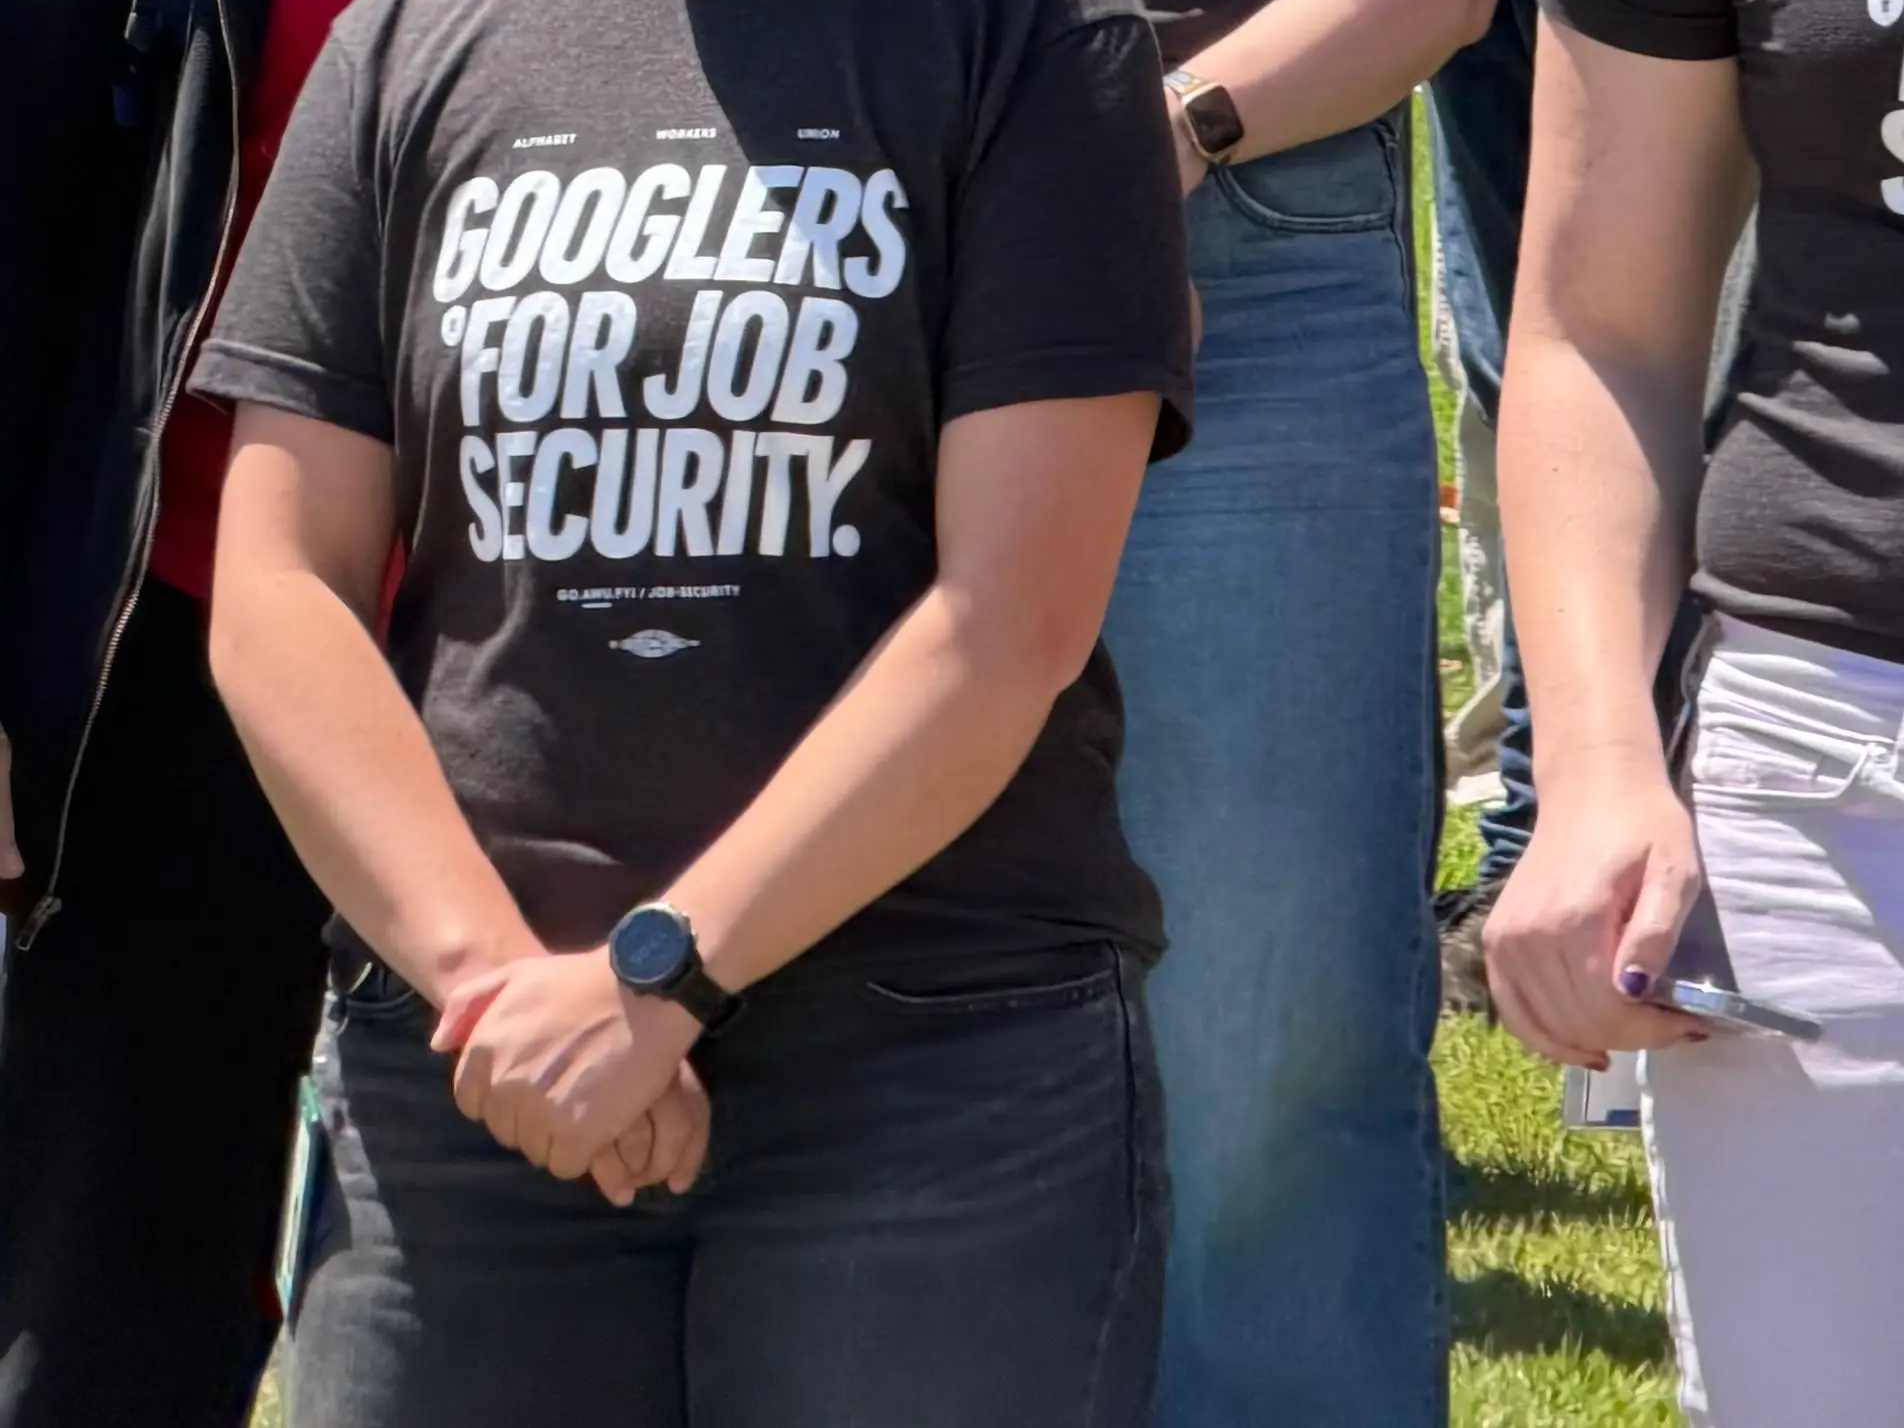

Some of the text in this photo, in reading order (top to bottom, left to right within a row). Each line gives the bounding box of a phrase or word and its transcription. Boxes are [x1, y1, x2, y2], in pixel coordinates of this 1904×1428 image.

[433, 164, 910, 303] GOOGLERS
[460, 290, 860, 427] FOR JOB
[459, 428, 873, 563] SECURITY.
